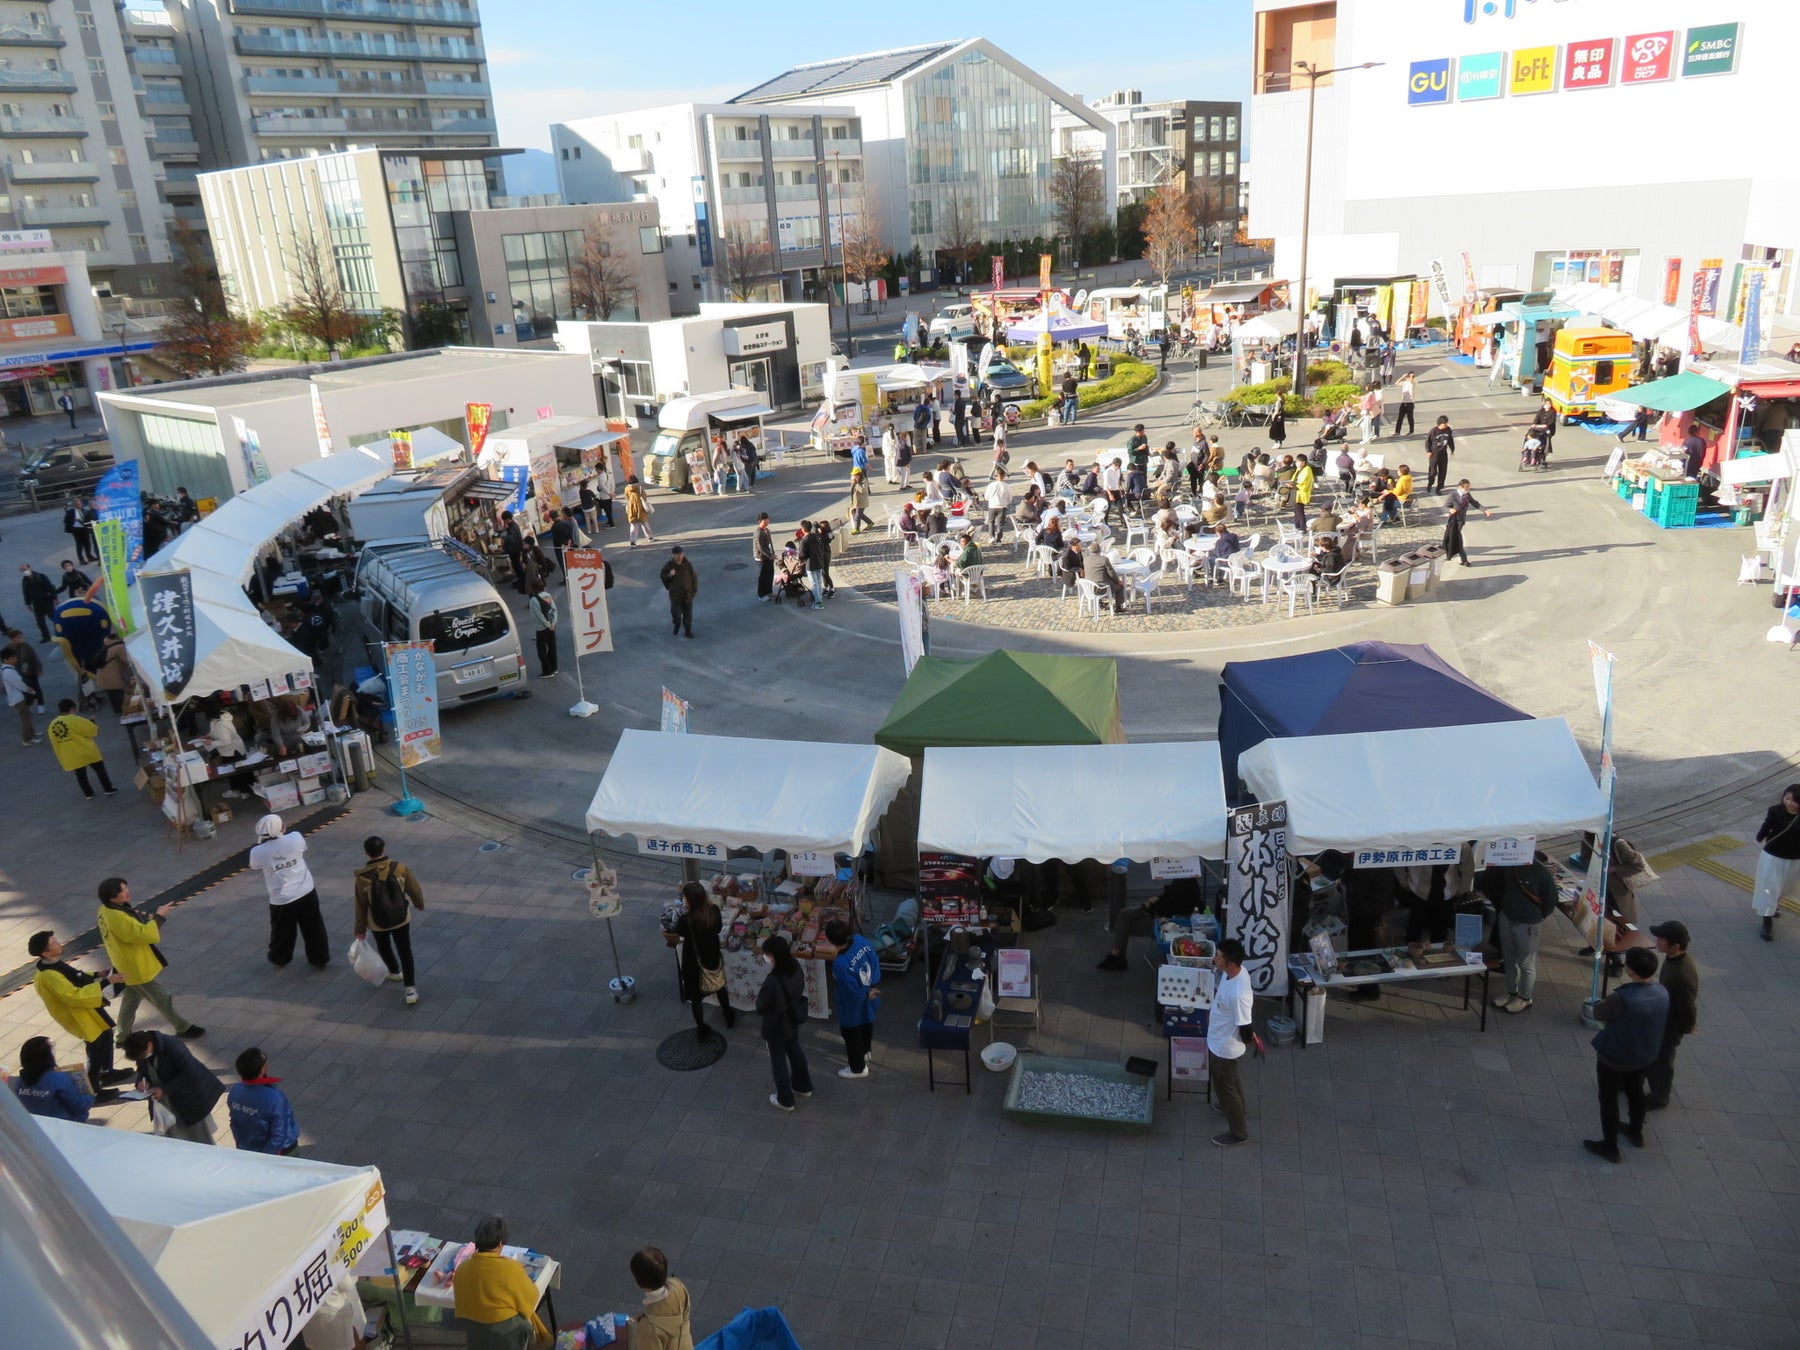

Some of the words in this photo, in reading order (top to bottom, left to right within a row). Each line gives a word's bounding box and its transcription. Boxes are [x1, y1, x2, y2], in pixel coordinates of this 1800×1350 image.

[1701, 38, 1733, 51] SMBC
[1574, 48, 1604, 63] 無印
[1410, 70, 1447, 93] GU
[1571, 64, 1603, 80] 良品
[578, 572, 605, 650] クレープ
[452, 613, 479, 629] Quest
[152, 590, 184, 683] 津久井城
[414, 652, 428, 694] かながわ
[396, 653, 412, 718] 商工会まつり
[1255, 805, 1286, 827] 真鶴
[647, 839, 717, 856] 逗子市商工会
[1358, 848, 1457, 864] 伊勢原市商工会
